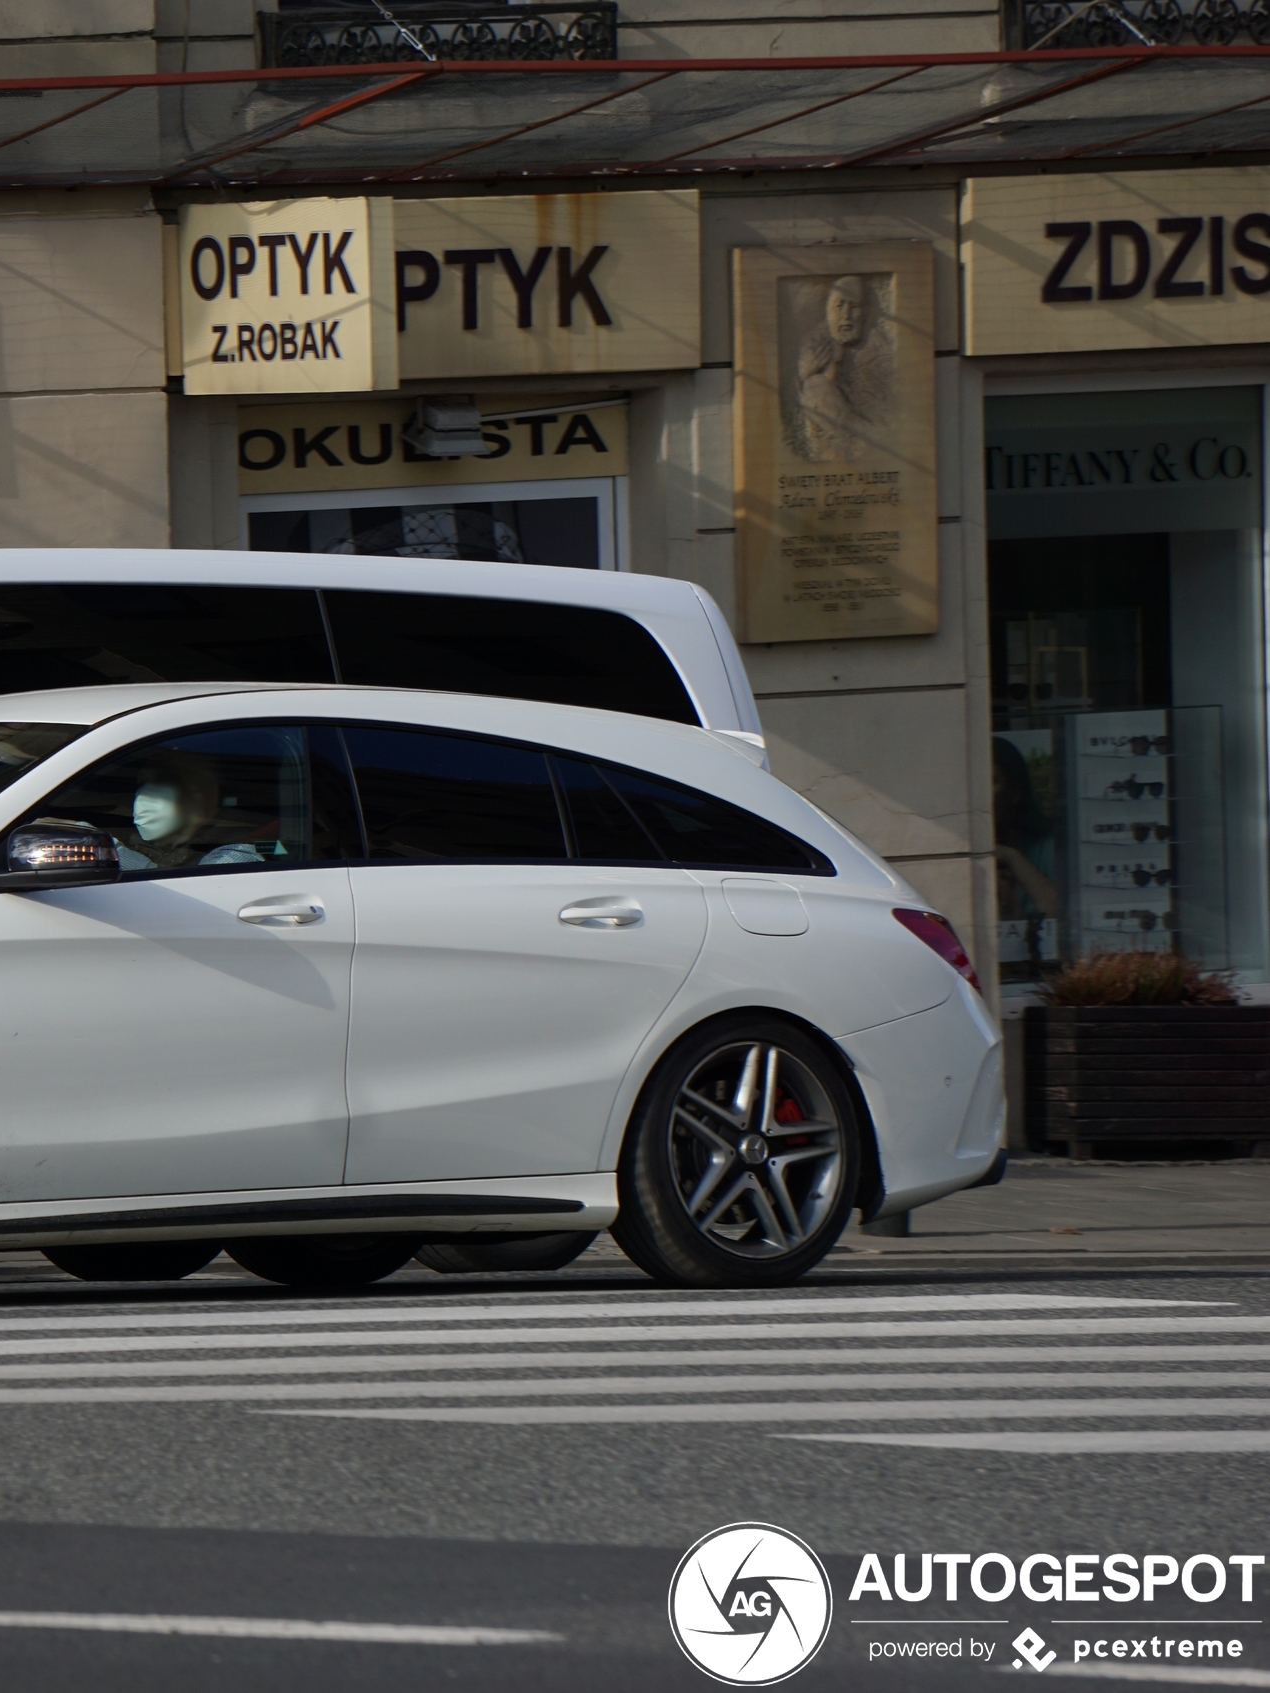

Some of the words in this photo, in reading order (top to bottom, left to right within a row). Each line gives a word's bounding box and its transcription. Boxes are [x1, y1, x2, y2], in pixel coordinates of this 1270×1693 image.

[190, 230, 357, 301] OPTYK
[1042, 212, 1270, 303] ZDZIS
[210, 320, 342, 363] Z.ROBAK
[239, 414, 608, 471] OKULSTA
[1150, 442, 1180, 482] &
